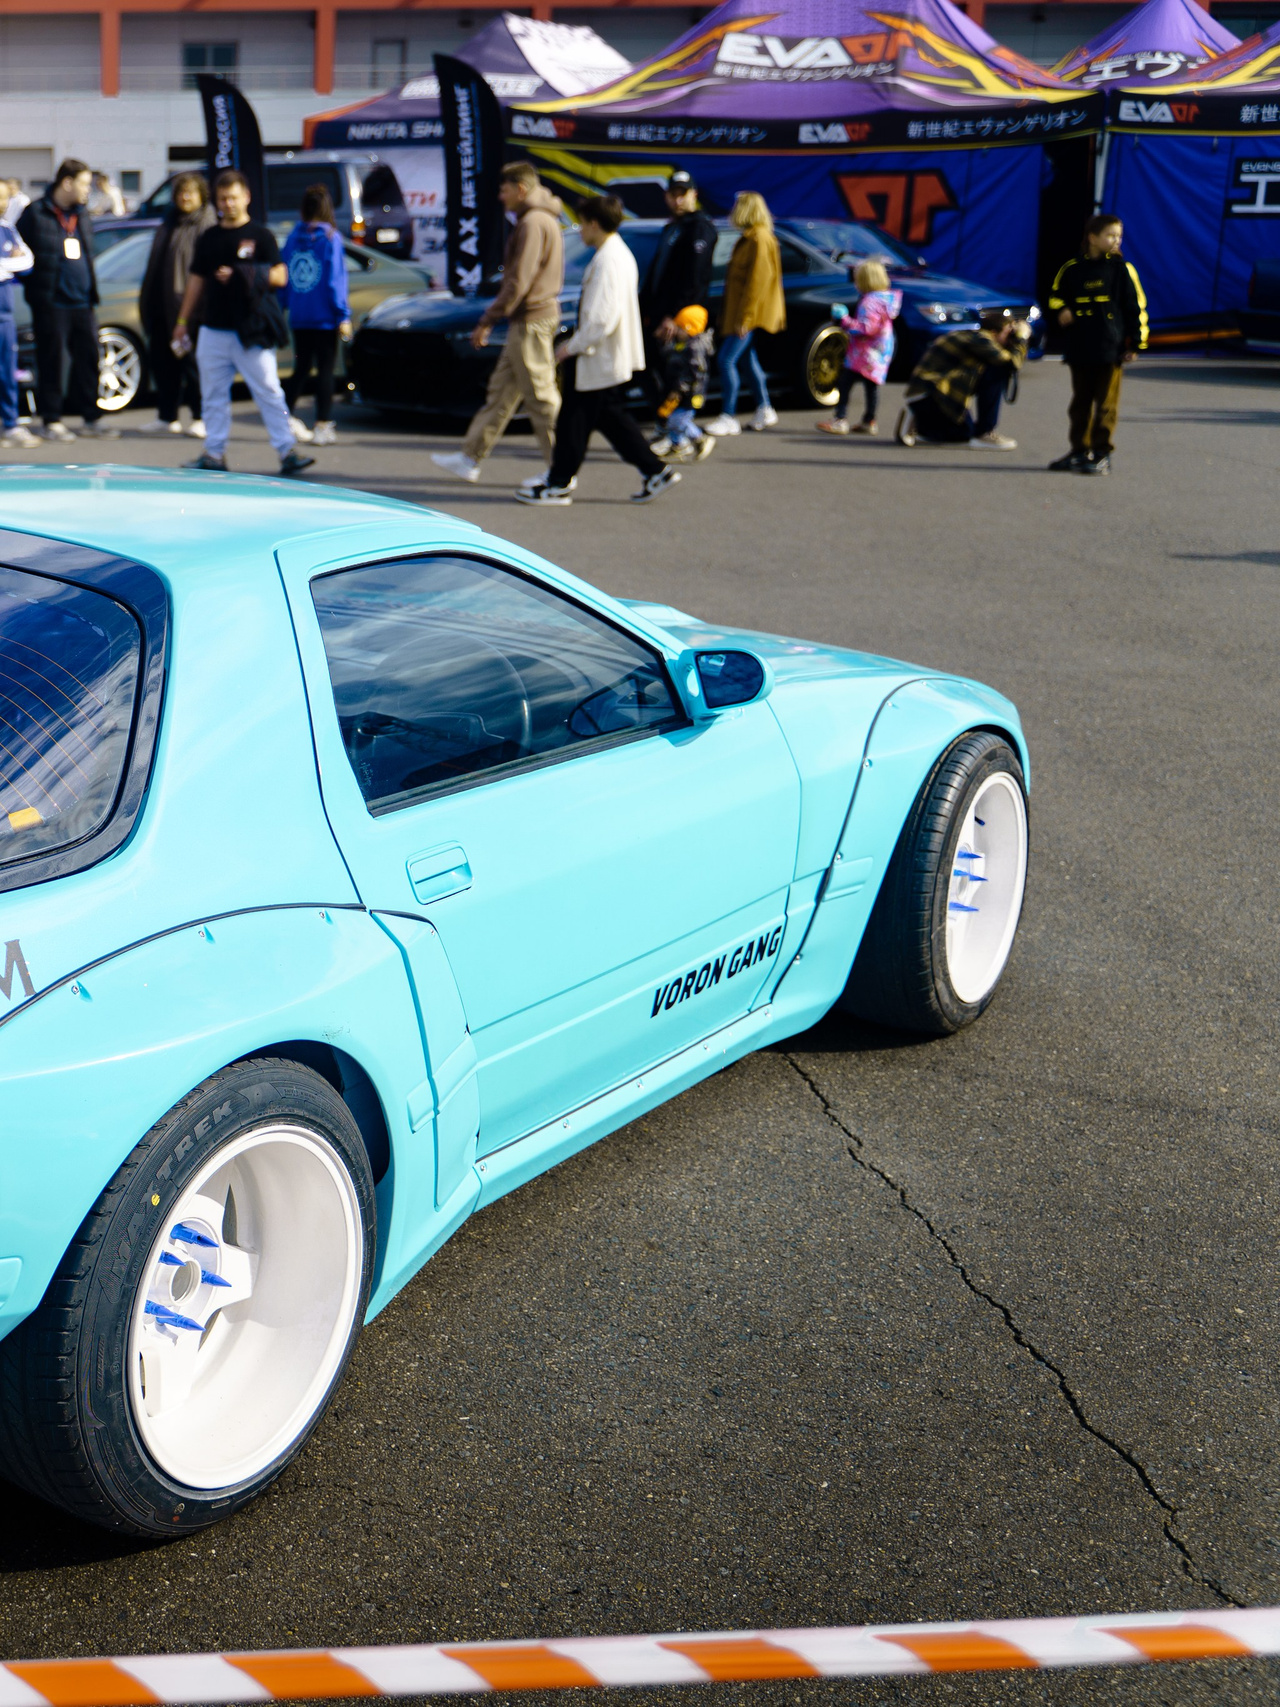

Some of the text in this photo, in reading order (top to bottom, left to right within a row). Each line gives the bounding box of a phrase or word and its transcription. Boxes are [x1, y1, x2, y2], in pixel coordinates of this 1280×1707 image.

[1239, 103, 1280, 124] 新世
[650, 925, 782, 1018] VORON GANG
[111, 1099, 234, 1281] MAXTREK
